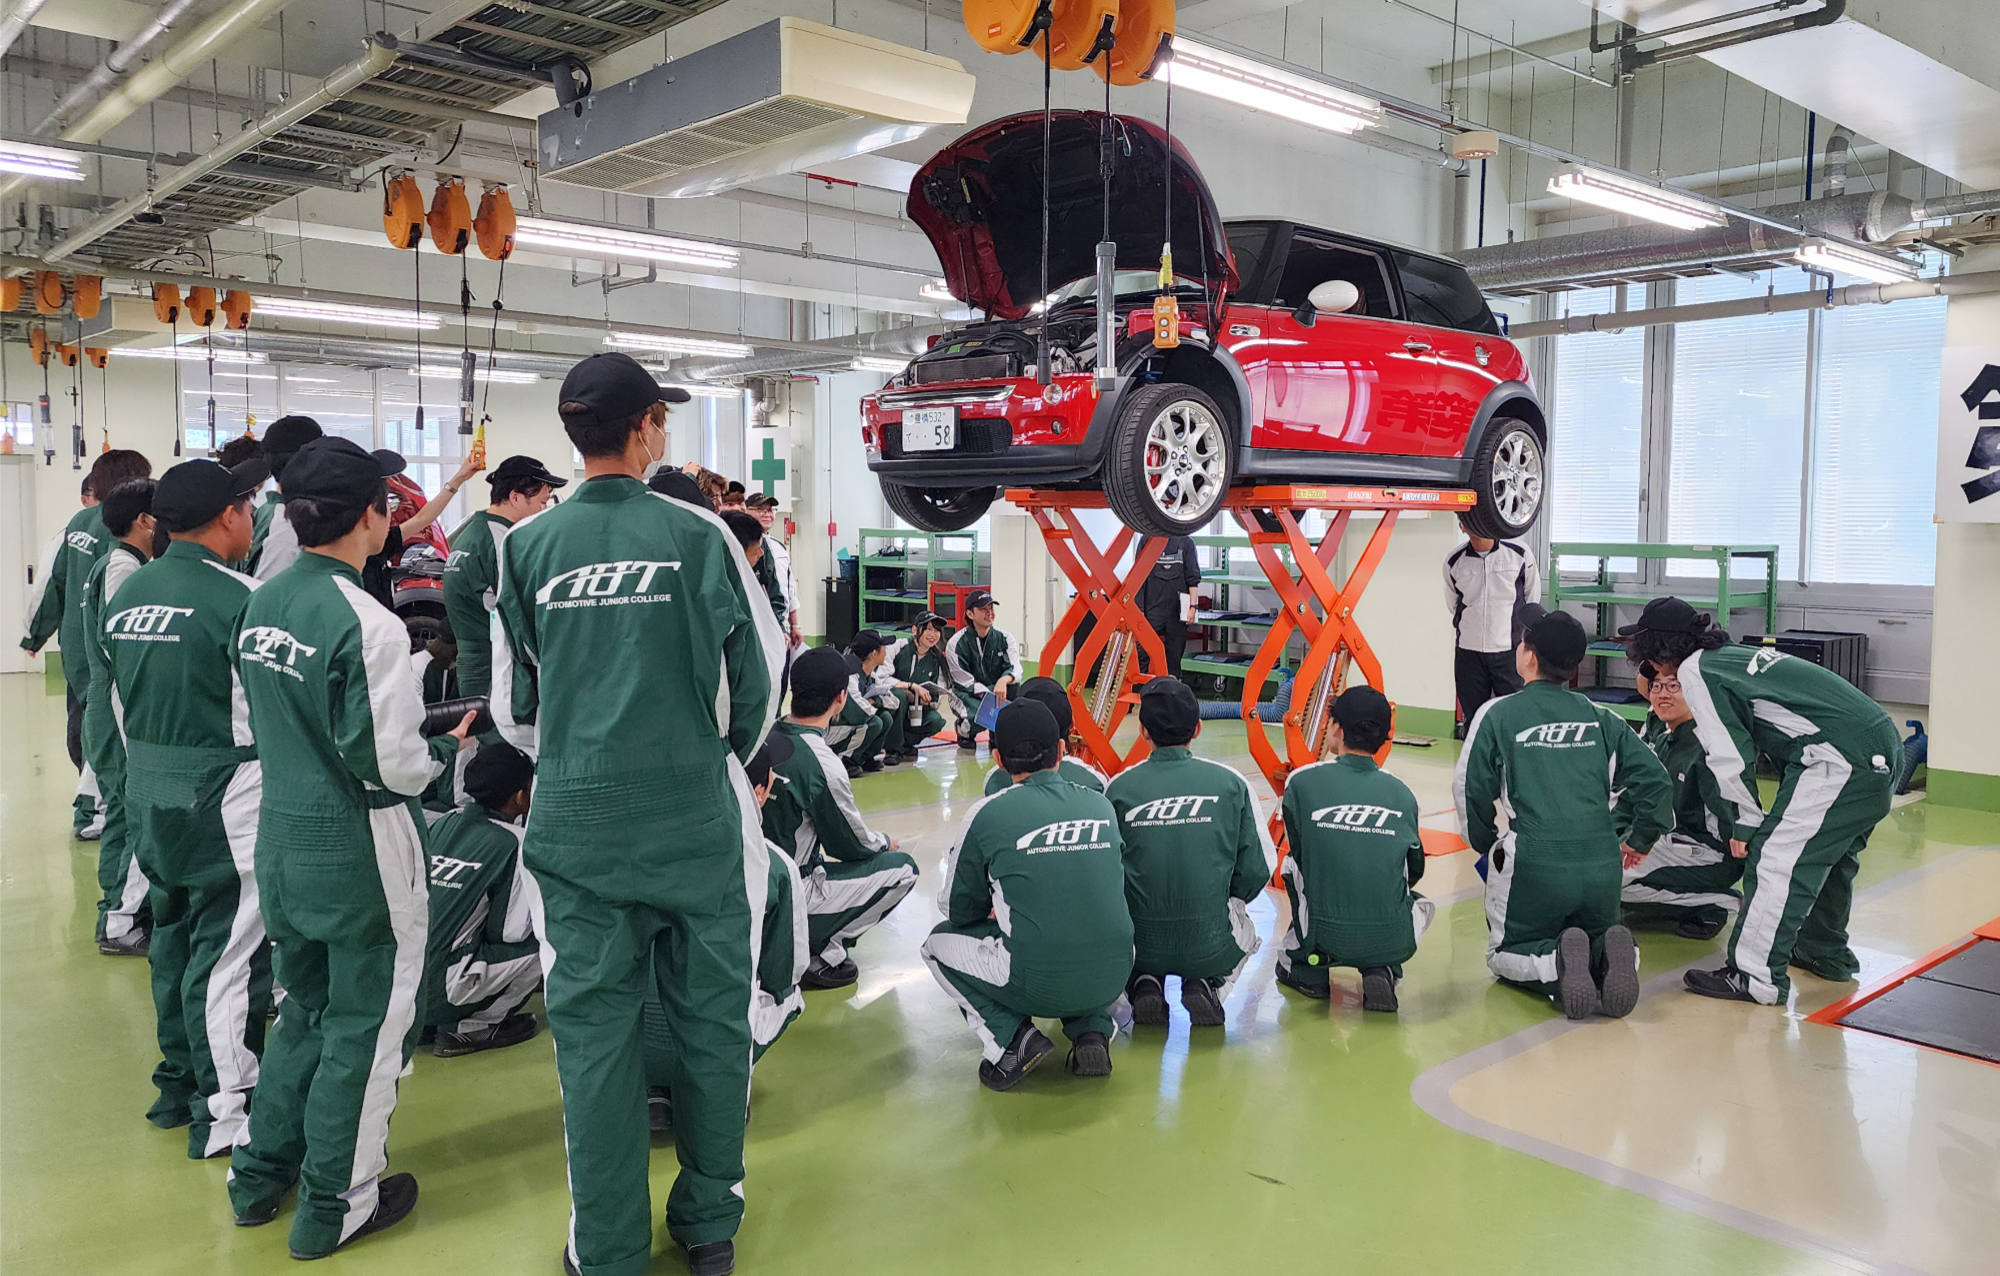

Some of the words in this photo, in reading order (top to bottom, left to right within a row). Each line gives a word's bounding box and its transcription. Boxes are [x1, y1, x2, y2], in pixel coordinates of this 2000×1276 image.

[929, 411, 942, 423] 532
[934, 424, 951, 446] 58
[1347, 490, 1373, 500] BANZAI
[599, 596, 630, 606] JUNIOR
[630, 594, 672, 604] COLLEGE
[1571, 740, 1597, 748] COLLEGE
[1131, 820, 1164, 828] AUTOMOTIVE
[1164, 818, 1185, 826] JUNIOR
[1185, 816, 1212, 824] COLLEGE
[1316, 821, 1350, 832] AUTOMOTIVE
[1026, 845, 1066, 855] AUTOMOTIVE
[1067, 843, 1088, 852] JUNIOR
[437, 880, 463, 890] COLLEGE
